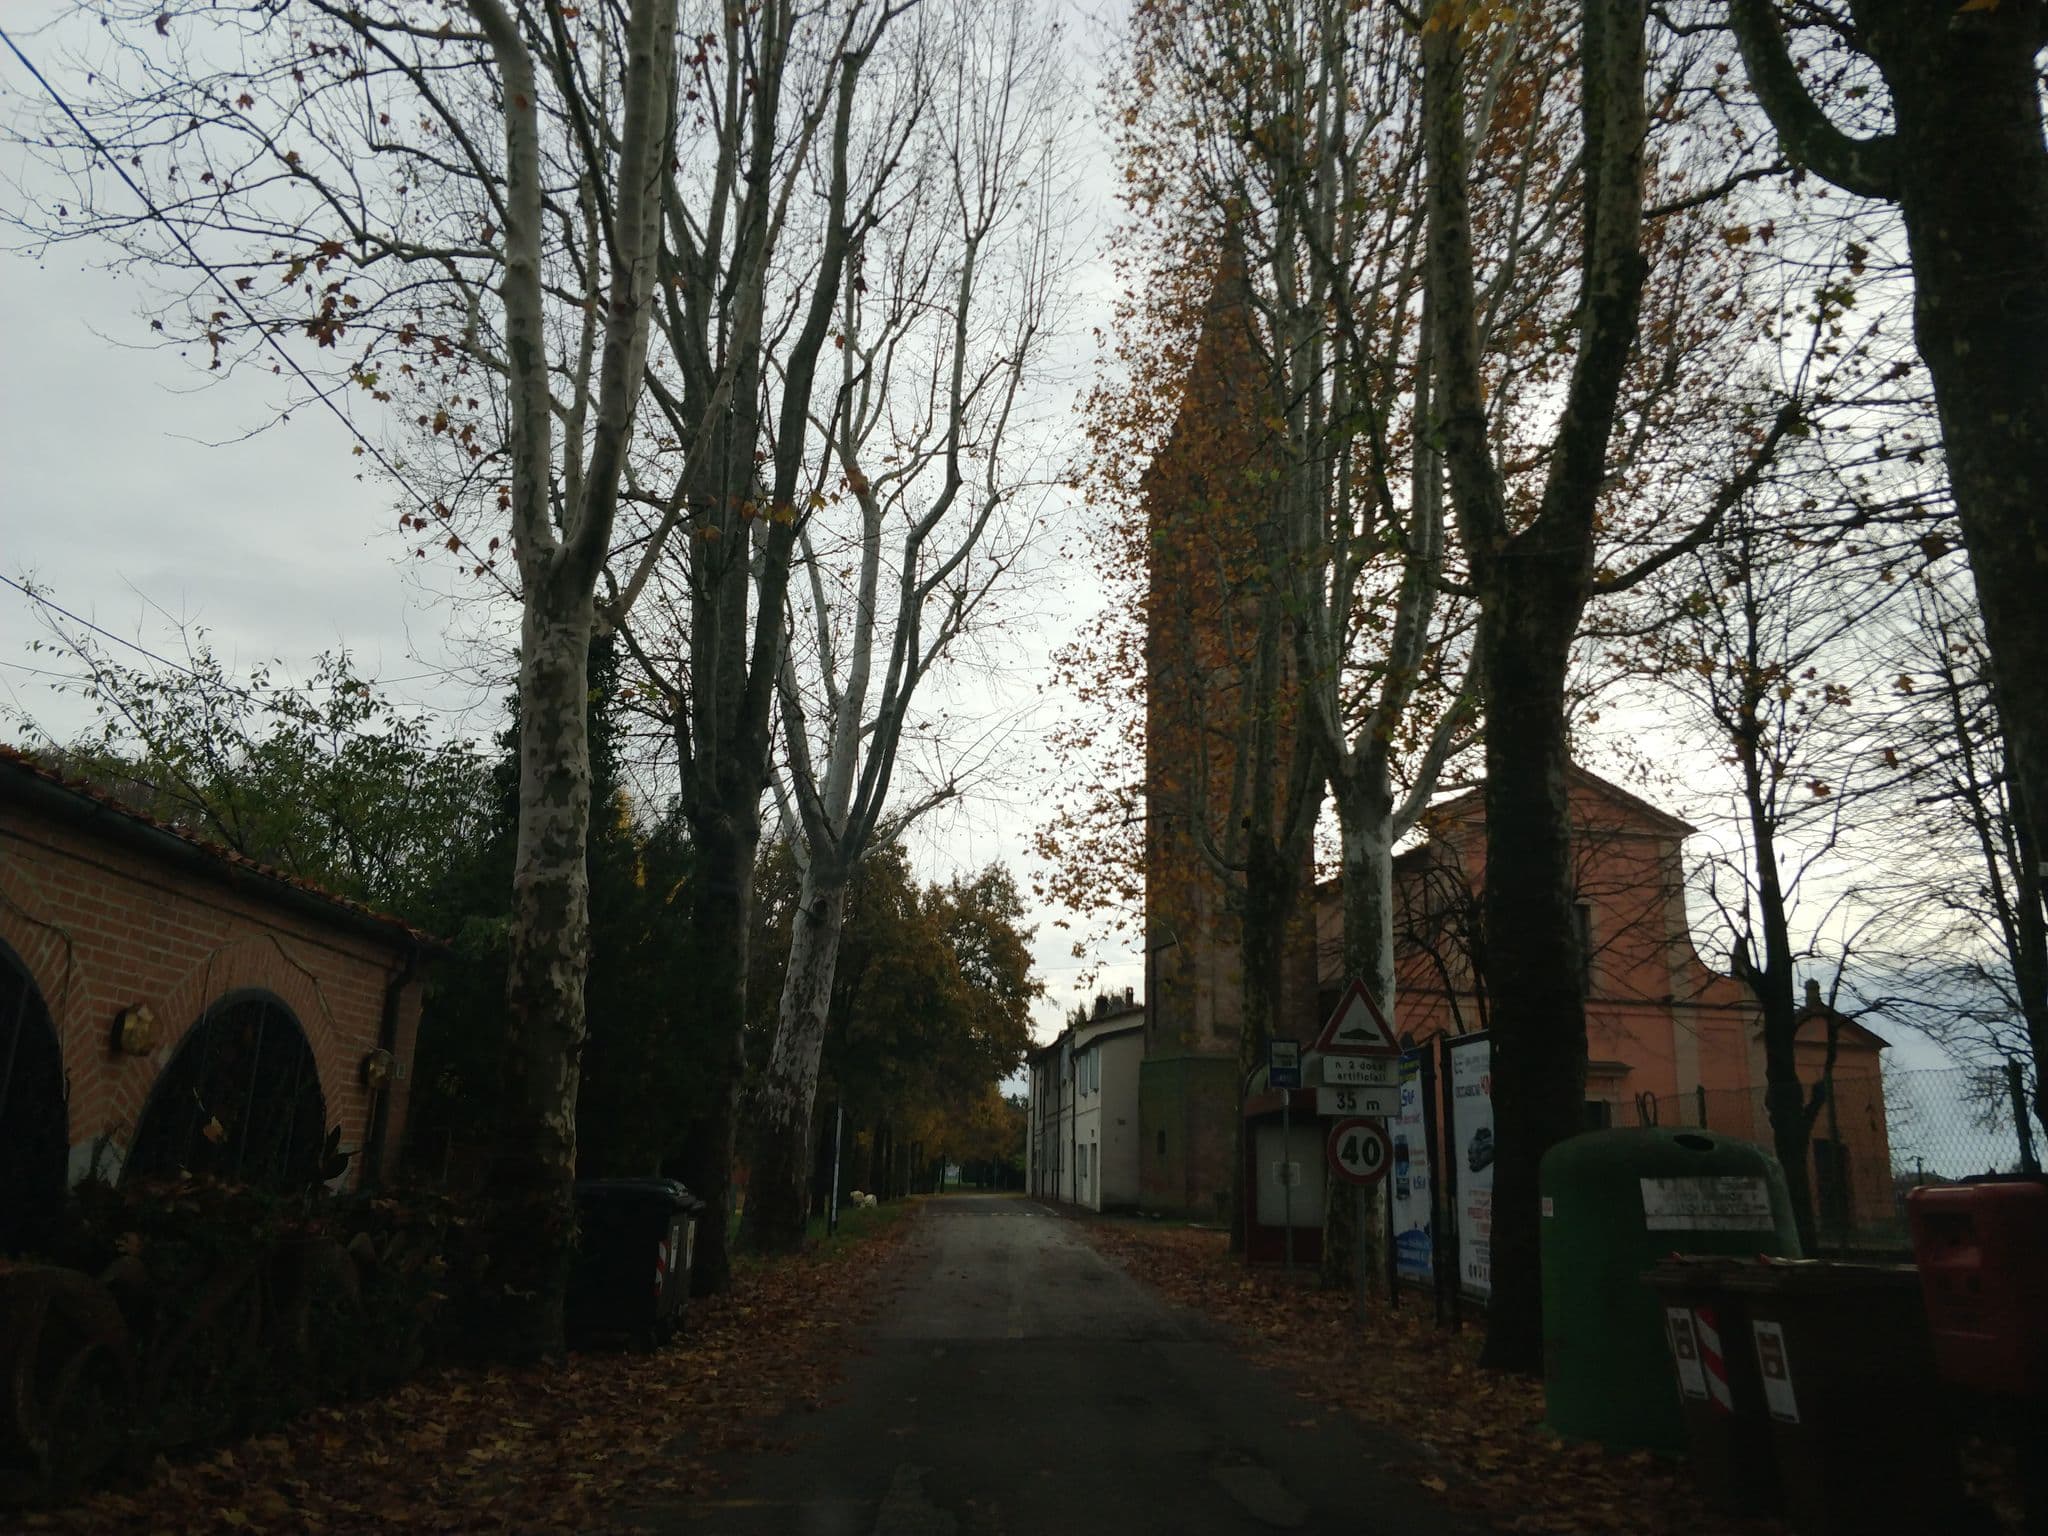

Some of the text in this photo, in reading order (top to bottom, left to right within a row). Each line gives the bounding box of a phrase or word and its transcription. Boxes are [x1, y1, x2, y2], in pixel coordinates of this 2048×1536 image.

[1348, 1060, 1355, 1070] 2
[1336, 1092, 1380, 1111] 35 m
[1341, 1135, 1381, 1167] 40
